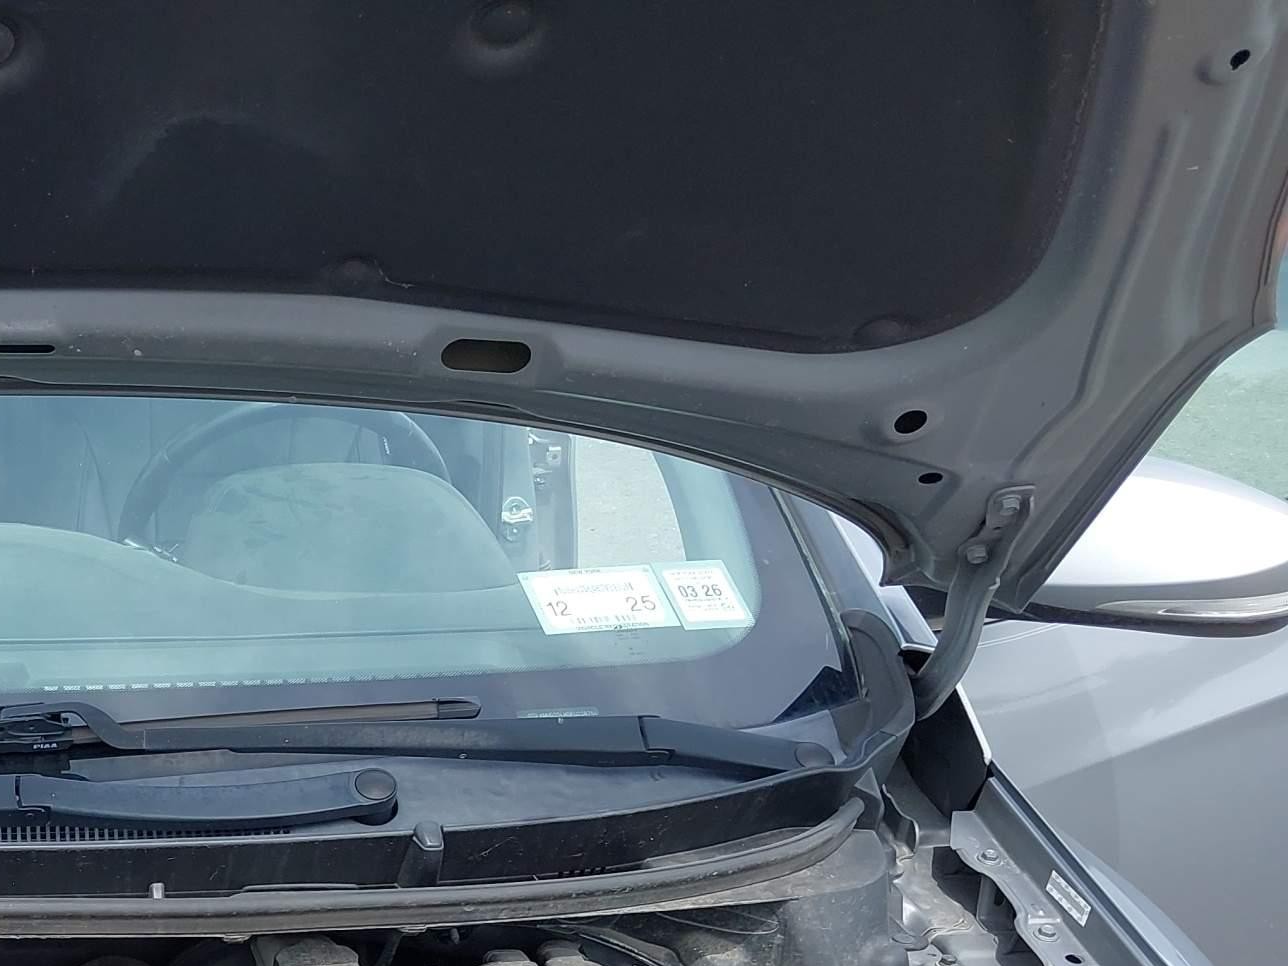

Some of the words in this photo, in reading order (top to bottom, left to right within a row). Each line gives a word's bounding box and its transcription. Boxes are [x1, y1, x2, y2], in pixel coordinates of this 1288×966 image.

[678, 585, 698, 598] 03
[701, 583, 722, 597] 26
[546, 600, 573, 617] 12
[625, 595, 656, 612] 25
